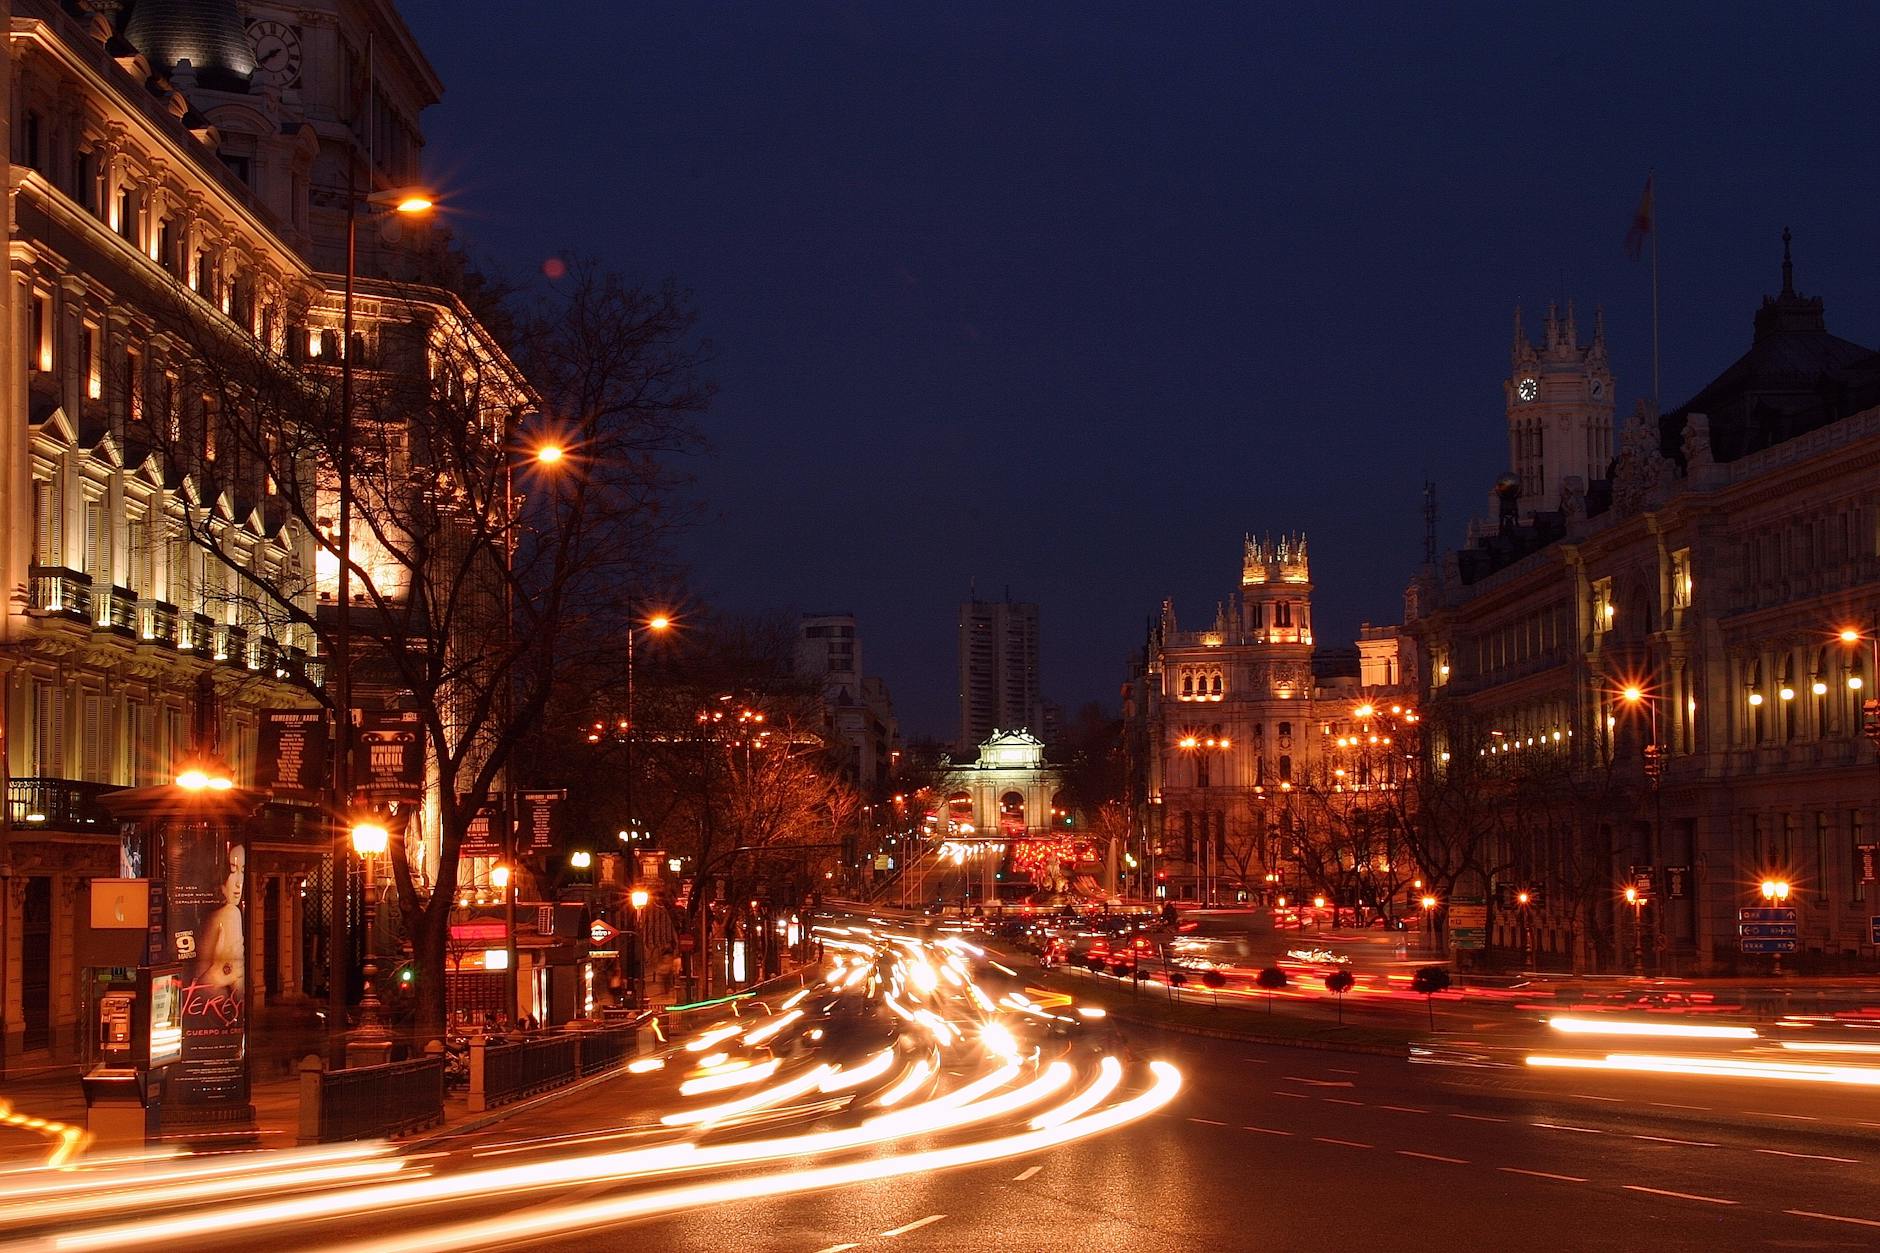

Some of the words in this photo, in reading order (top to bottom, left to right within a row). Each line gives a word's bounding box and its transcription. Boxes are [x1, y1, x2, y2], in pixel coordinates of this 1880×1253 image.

[371, 745, 404, 753] HOMEBODY
[371, 753, 404, 766] KABUL
[176, 936, 195, 953] 9
